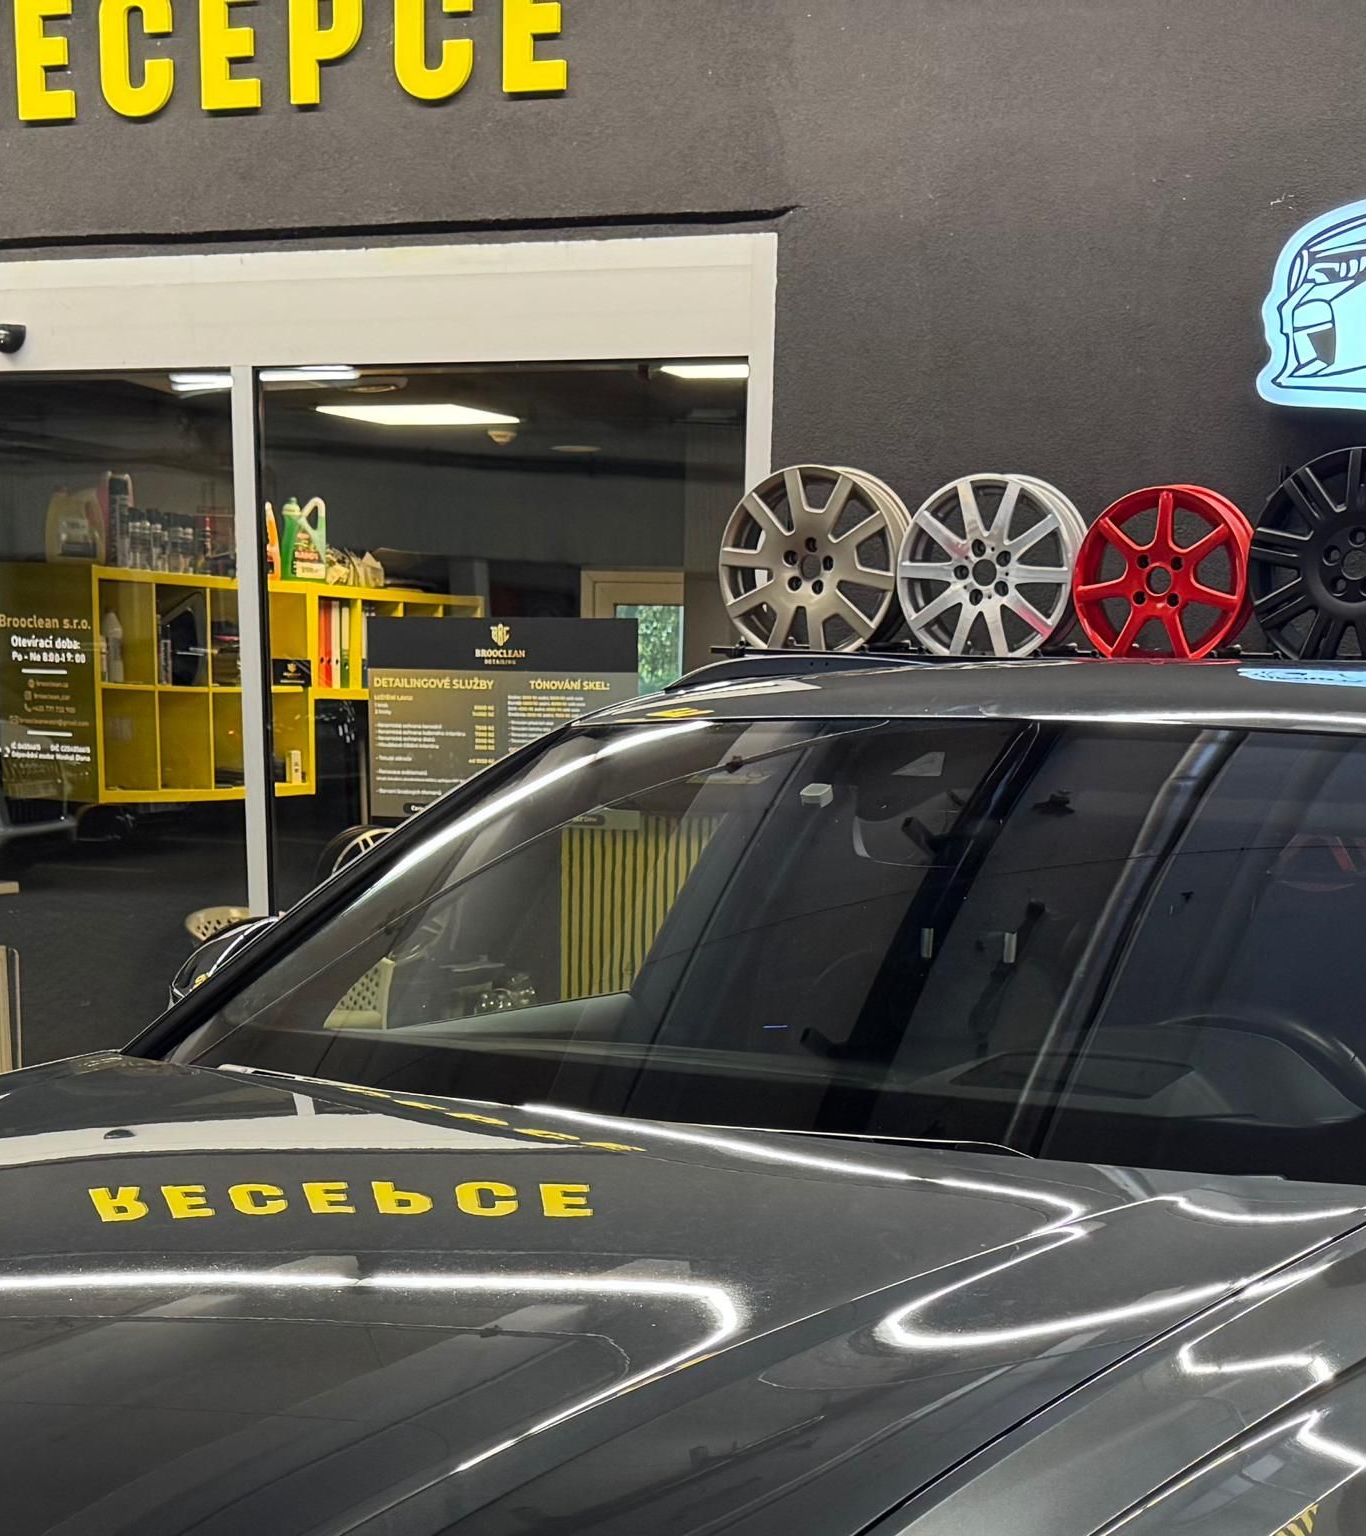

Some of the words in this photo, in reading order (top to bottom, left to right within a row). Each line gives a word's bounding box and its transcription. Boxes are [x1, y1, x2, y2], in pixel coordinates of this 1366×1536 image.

[62, 618, 92, 630] s.r.o.
[55, 637, 81, 650] doba:
[11, 651, 23, 662] Po
[29, 652, 41, 662] Ne
[474, 648, 526, 659] BROOCLEAN
[373, 675, 451, 690] DETAILINGOVÉ
[452, 675, 495, 691] SLUŽBY
[529, 677, 582, 691] TÓNOVÁNÍ
[582, 679, 611, 691] SKEL:
